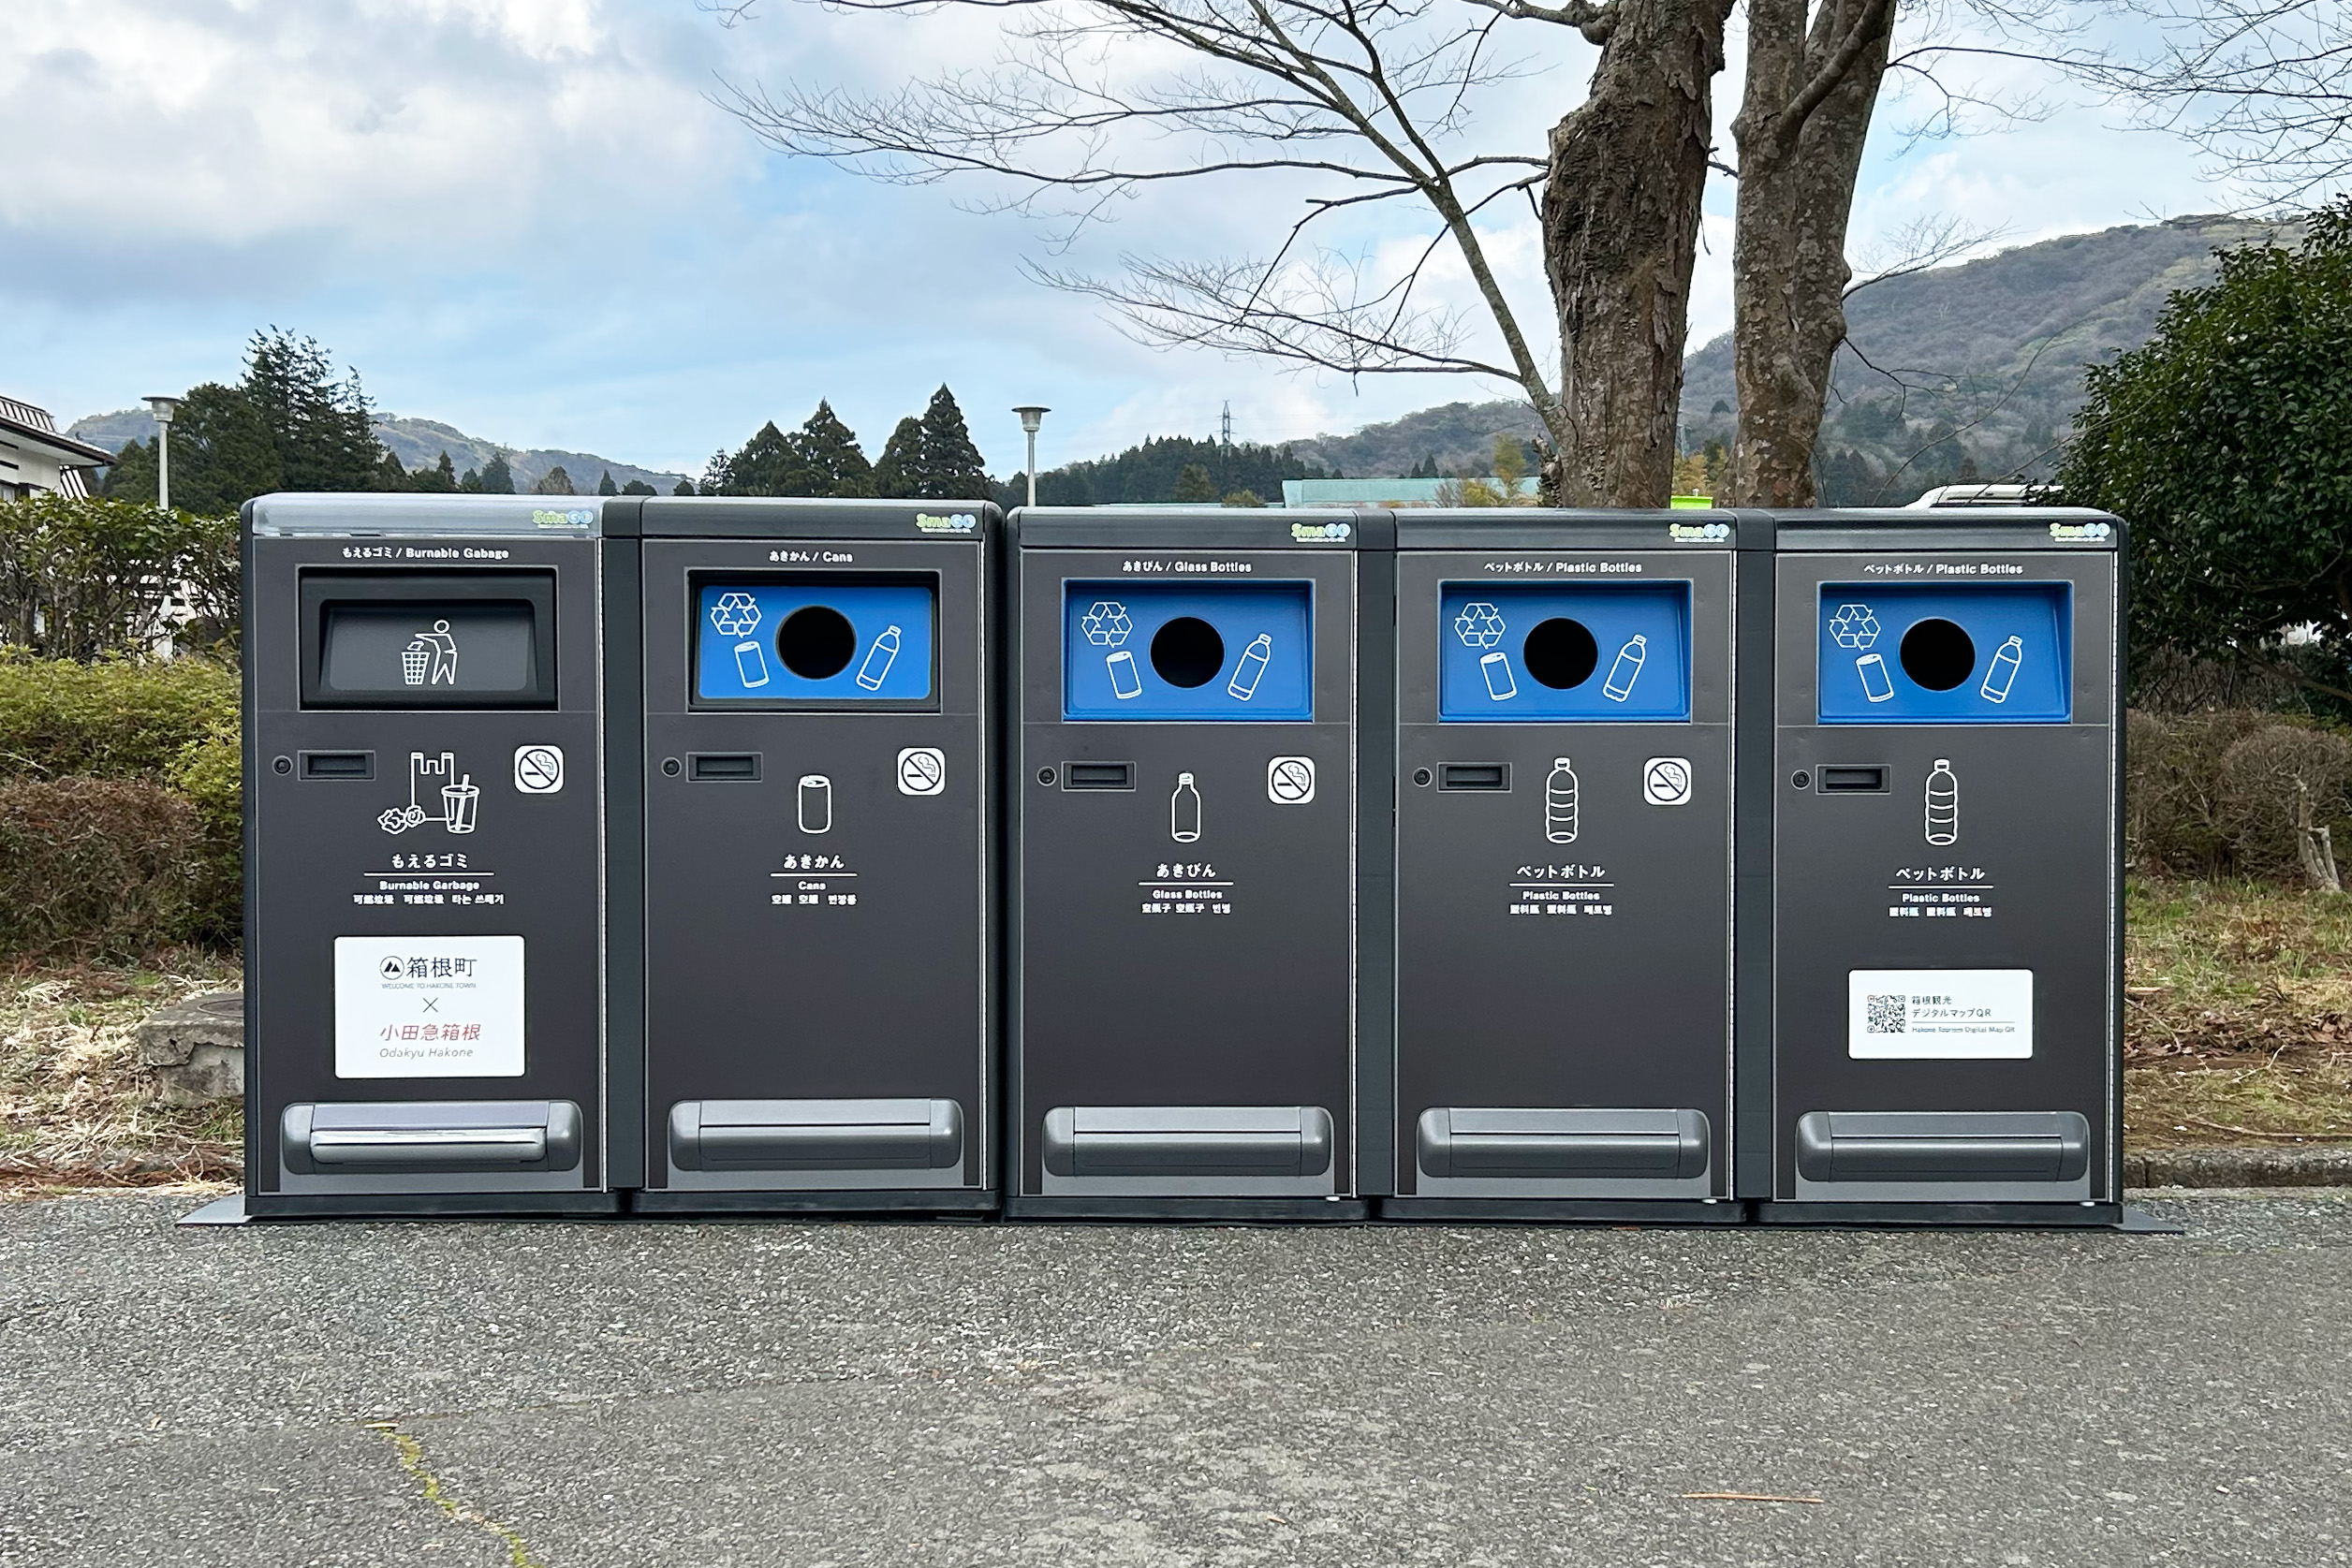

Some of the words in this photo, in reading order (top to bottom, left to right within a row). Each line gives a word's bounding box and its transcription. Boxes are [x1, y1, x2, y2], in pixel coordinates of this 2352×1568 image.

[405, 548, 460, 559] Burnable
[463, 548, 509, 560] Gabage
[769, 550, 810, 563] あきかん
[823, 551, 853, 563] Cans
[1174, 562, 1208, 572] Glass
[1211, 562, 1252, 573] Bottles
[1484, 562, 1544, 573] ペットボトル
[1555, 563, 1596, 573] Plastic
[1599, 563, 1642, 573] Bottles
[1864, 564, 1924, 575] ペットボトル
[1935, 564, 1977, 575] Plastic
[1980, 564, 2023, 575] Bottles
[391, 854, 468, 869] もえるゴミ
[783, 854, 845, 870] あきかん
[1156, 863, 1216, 878] あきびん
[1516, 864, 1606, 879] ペットボトル
[1895, 866, 1986, 882] ペットボトル
[379, 881, 430, 890] Burnable
[433, 881, 480, 891] Garbage
[798, 881, 826, 890] Cans
[1153, 889, 1183, 900] Glass
[1184, 889, 1223, 900] Bottles
[1522, 890, 1559, 901] Plastic
[1562, 891, 1600, 901] Bottles
[1902, 893, 1939, 903] Plastic
[1941, 893, 1980, 903] Bottles
[405, 957, 478, 979] 箱根町
[1911, 995, 1952, 1005] 箱根観光
[1911, 1008, 1992, 1018] デジタルマップQR
[379, 1023, 481, 1041] 小田急箱根
[379, 1048, 424, 1060] Odakyu
[428, 1048, 474, 1058] Hakone
